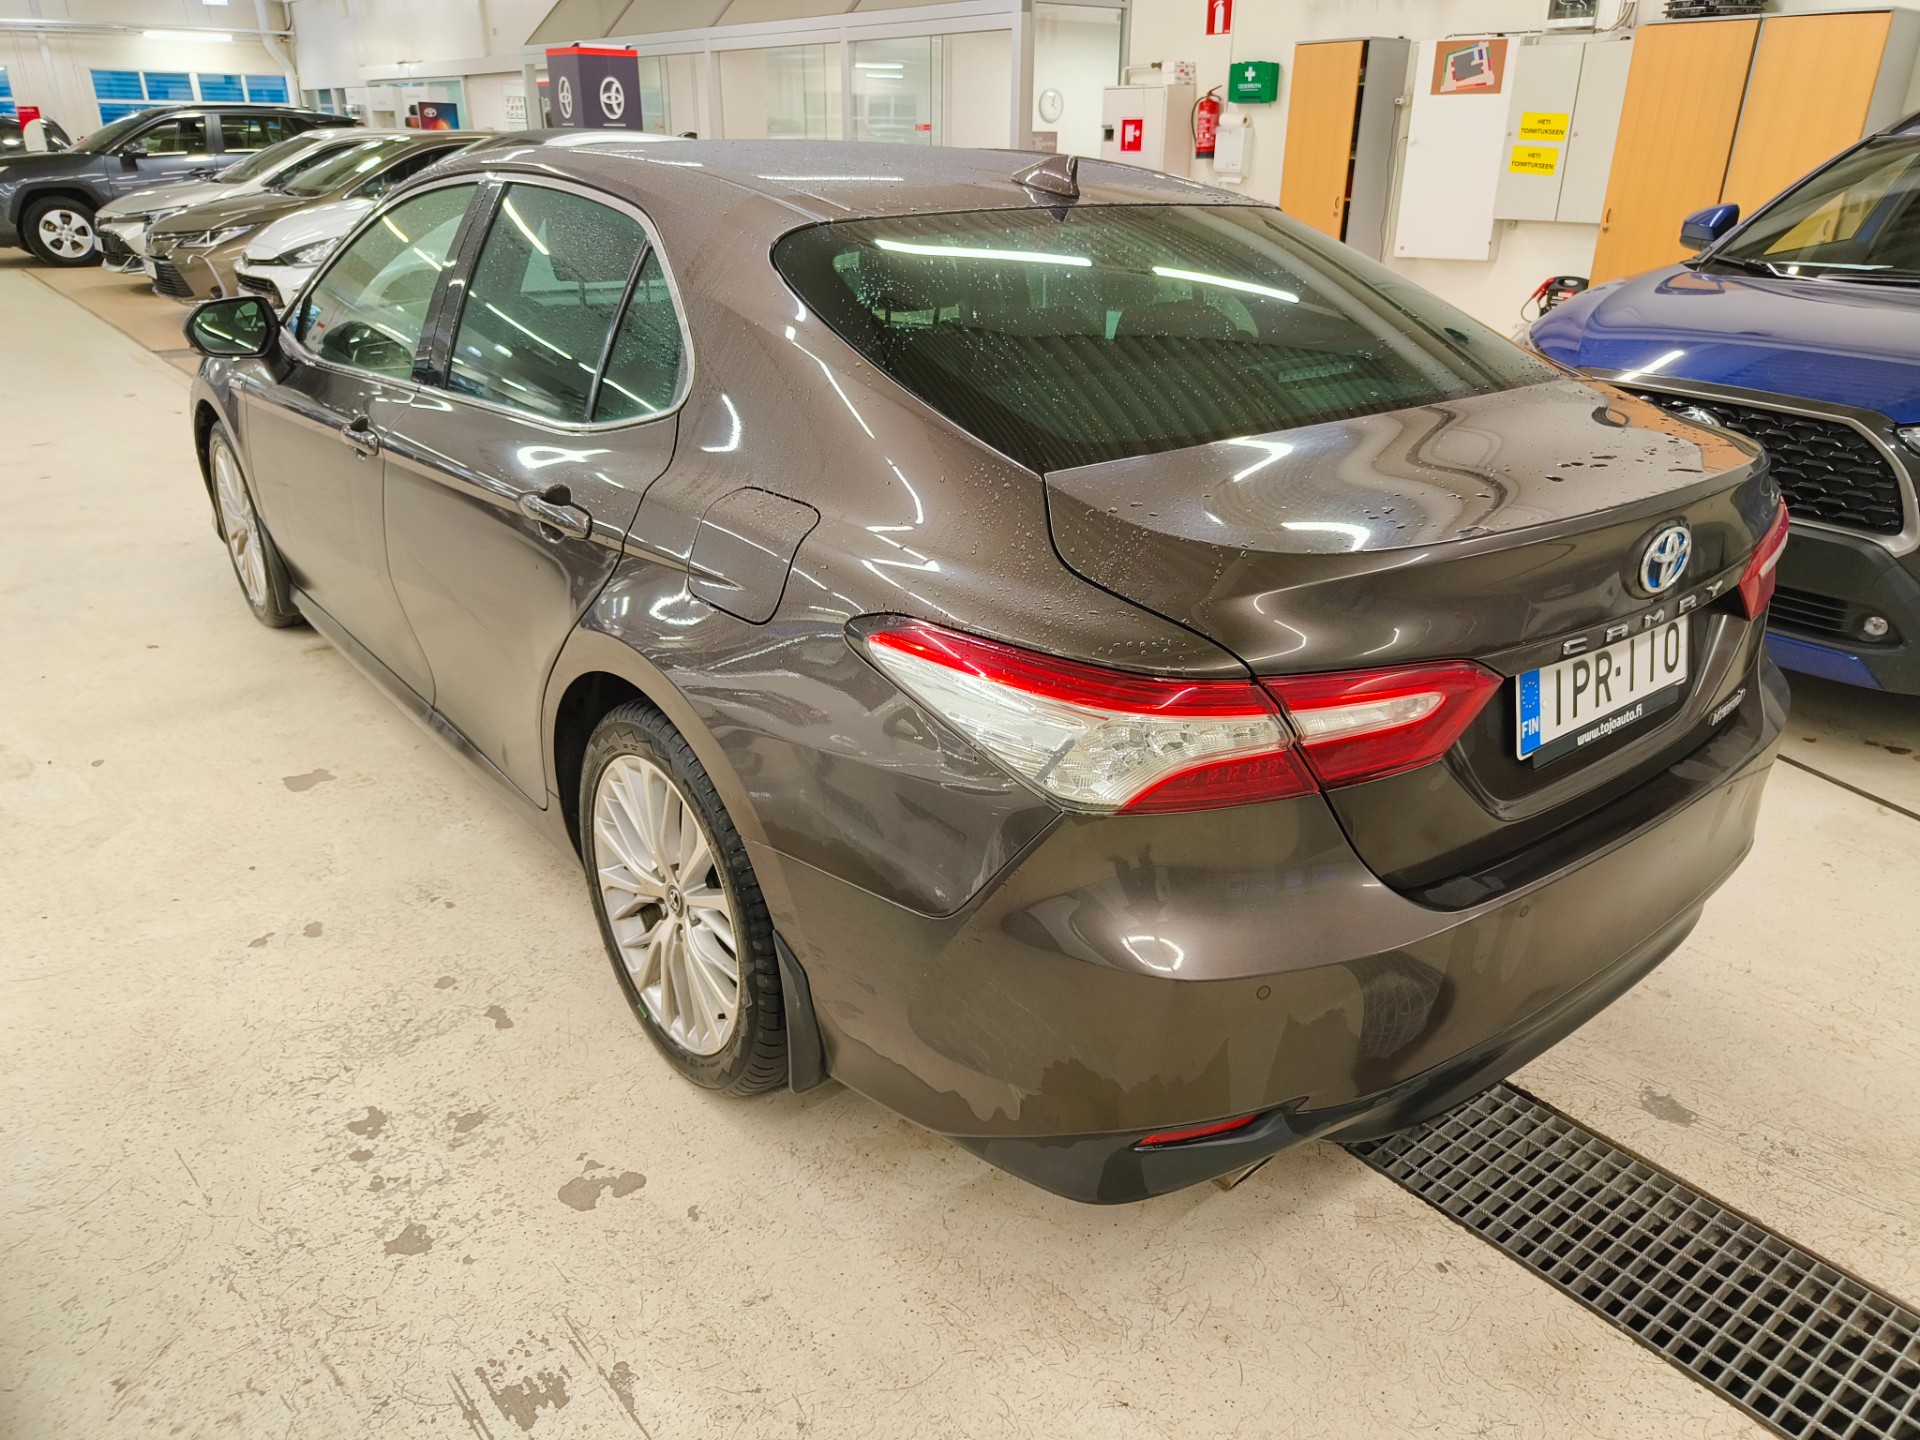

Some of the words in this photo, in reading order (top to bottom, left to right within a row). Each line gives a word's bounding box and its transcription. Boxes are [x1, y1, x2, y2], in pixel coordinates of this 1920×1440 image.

[1520, 127, 1565, 136] TOIMITUKSEEN
[1511, 160, 1554, 170] TOIMITUKSEEN
[1562, 580, 1723, 655] CAMRY
[1555, 622, 1680, 727] IPR-110
[1521, 716, 1539, 739] FIN
[1576, 703, 1643, 746] www.tojoauto.fi
